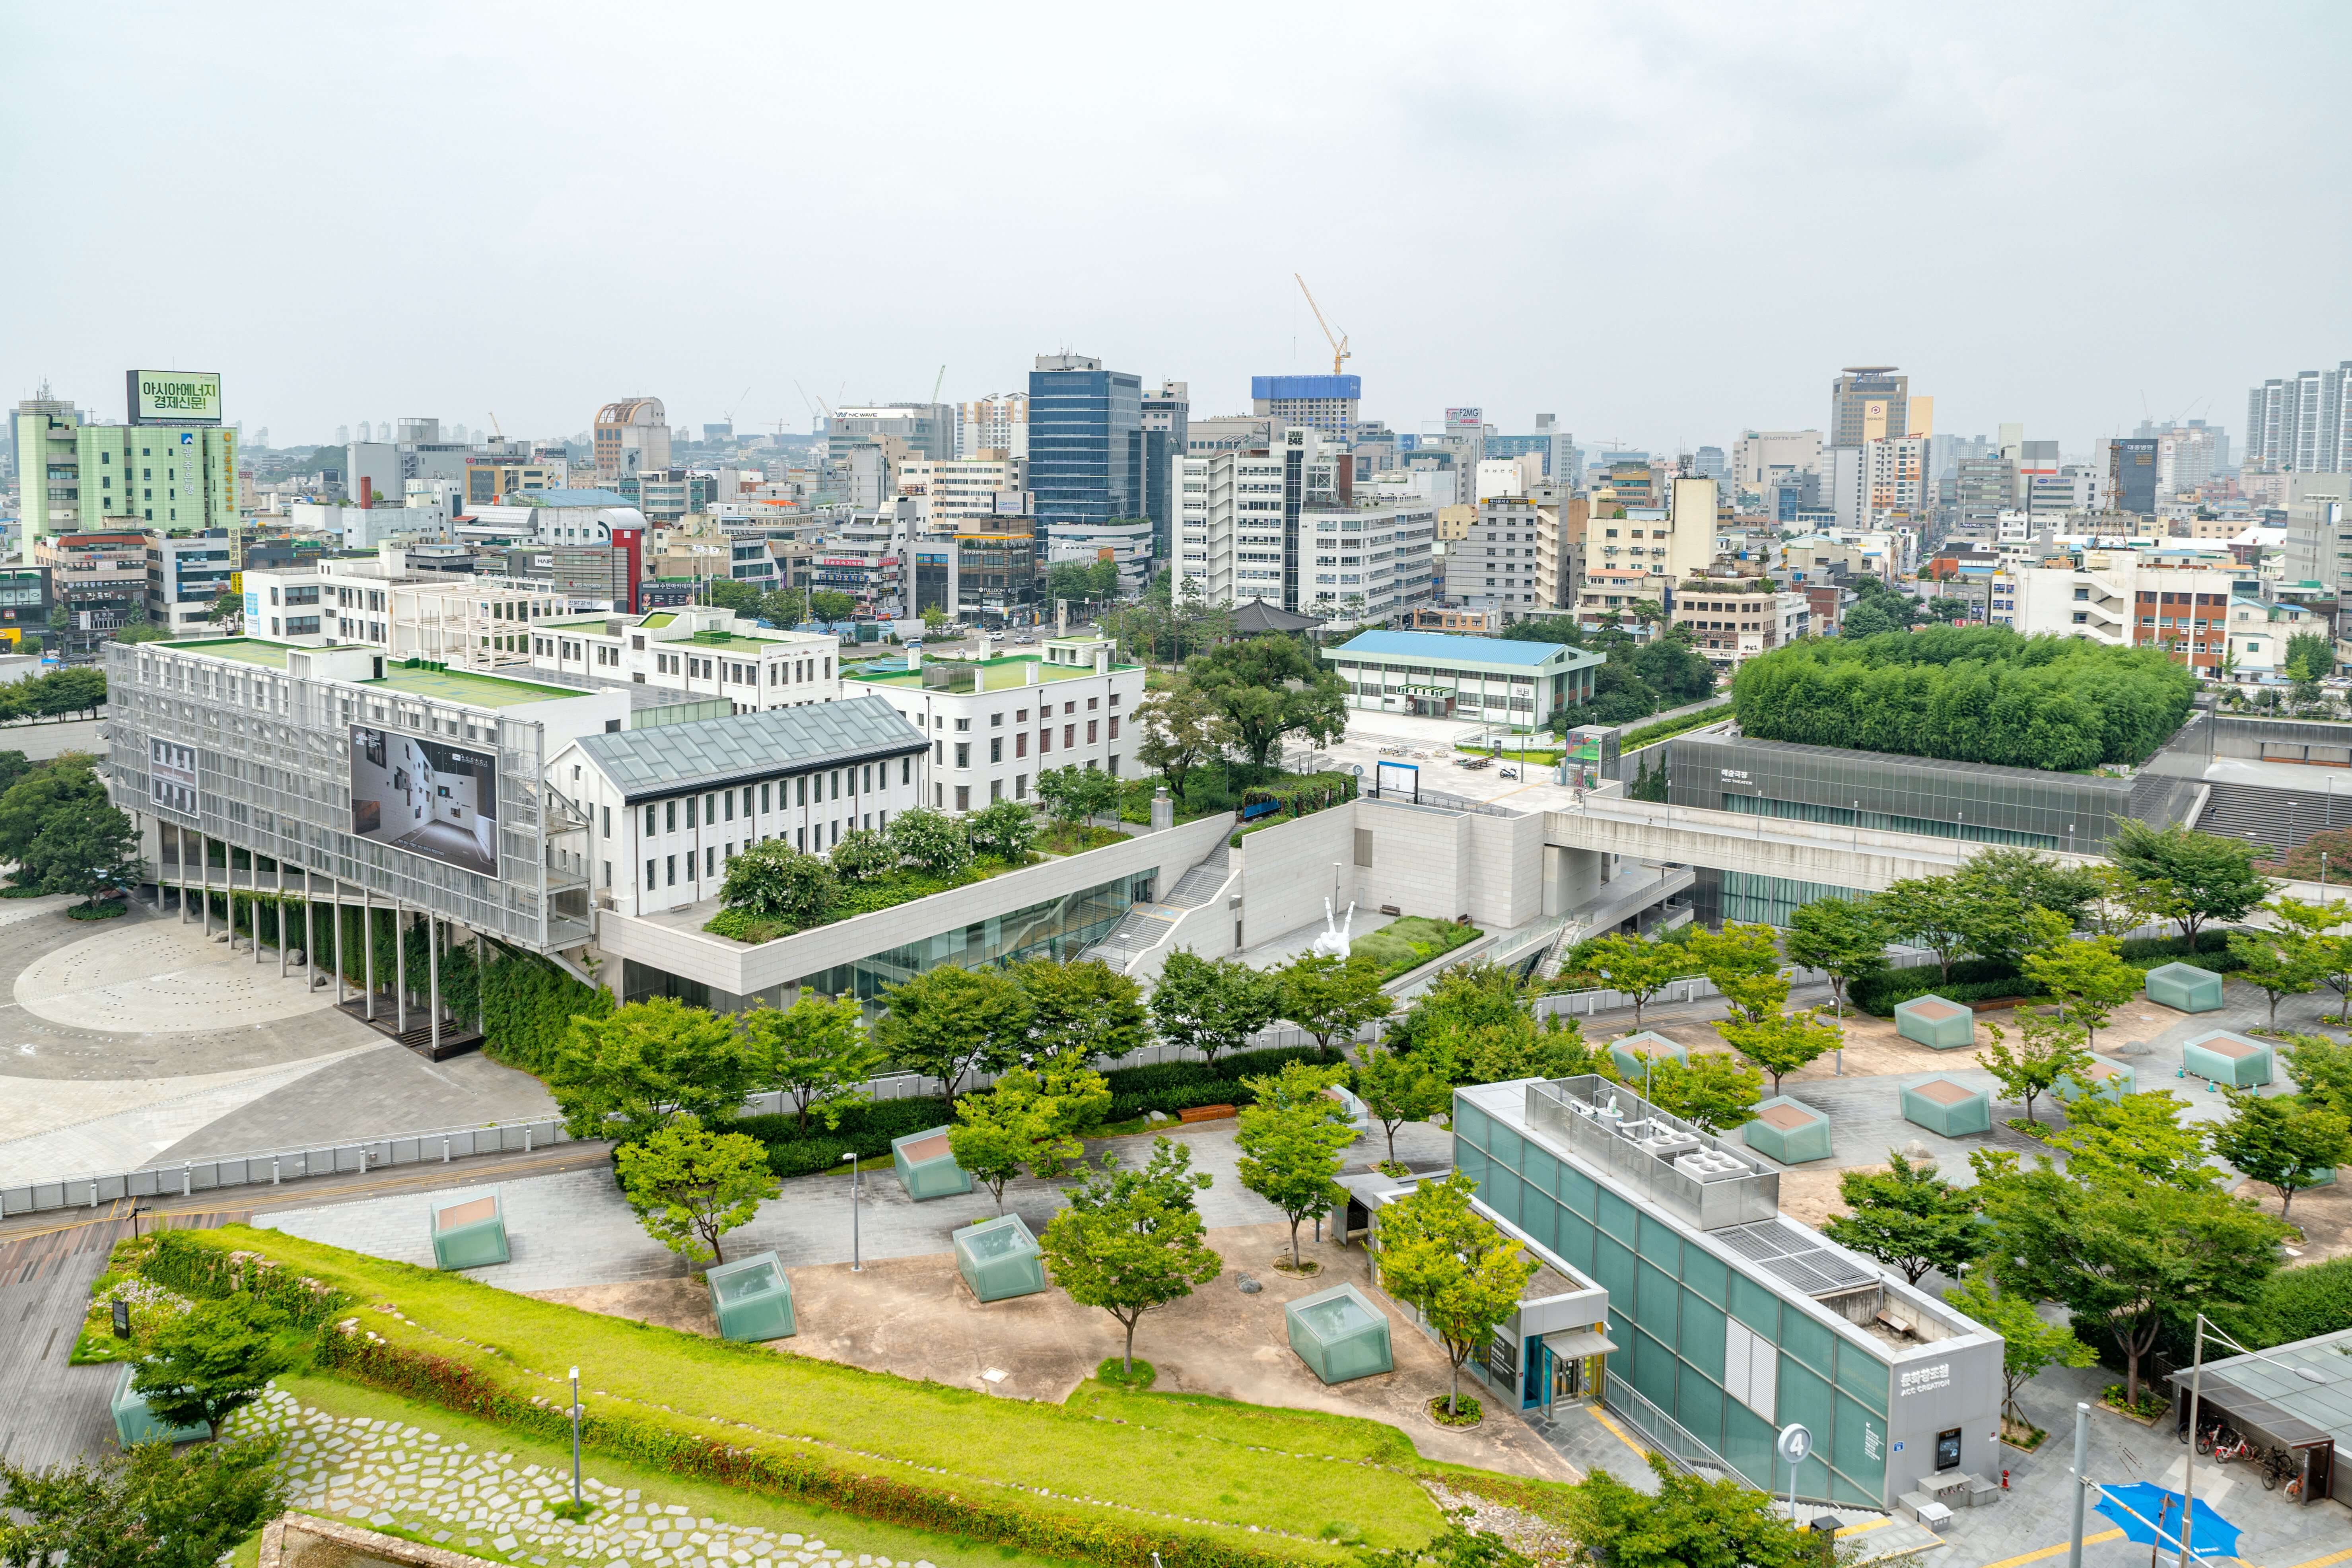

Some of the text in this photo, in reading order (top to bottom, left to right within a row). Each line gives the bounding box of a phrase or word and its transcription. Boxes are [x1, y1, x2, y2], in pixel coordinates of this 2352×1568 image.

[143, 382, 216, 397] 아시아에너지
[154, 396, 206, 409] 경제신문!
[182, 448, 194, 495] 광주은행
[230, 529, 239, 566] 방탈출카페
[1721, 769, 1748, 779] 예술극장
[1901, 1364, 1950, 1387] 문화창조원
[1901, 1379, 1950, 1396] ACC CREATION
[1790, 1433, 1804, 1456] 4
